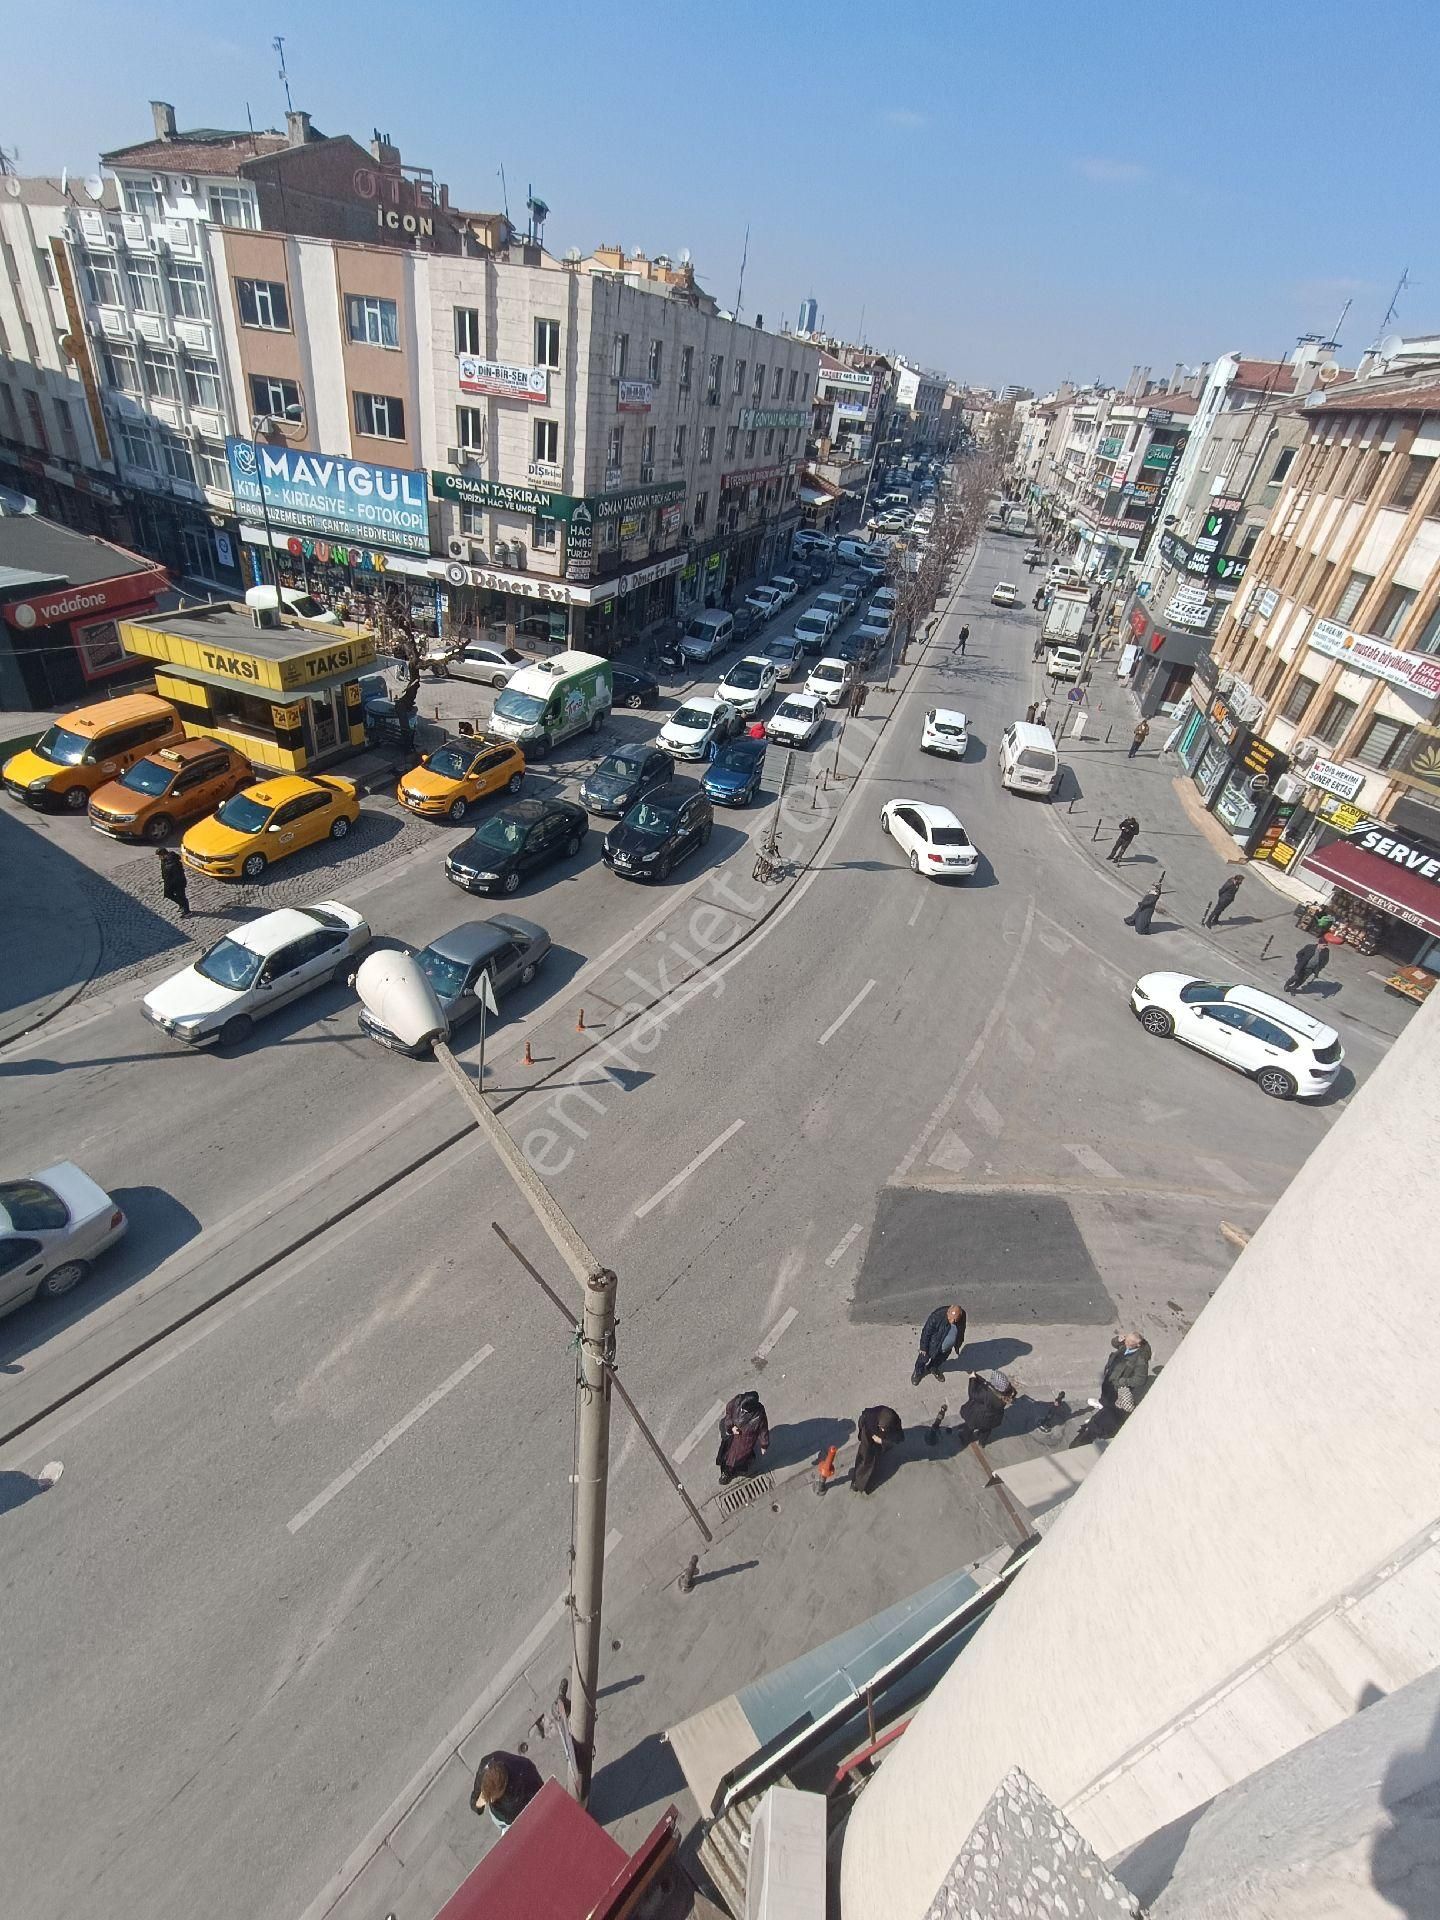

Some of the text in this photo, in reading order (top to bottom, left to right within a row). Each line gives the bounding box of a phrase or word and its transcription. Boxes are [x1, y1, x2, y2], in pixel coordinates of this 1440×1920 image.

[353, 168, 459, 214] OTEL
[261, 447, 422, 507] MAVİGÜL
[445, 476, 551, 507] OSMAN TAŞKIRAN
[458, 492, 537, 515] TURİZM HAC VE UMRE
[237, 479, 424, 530] KİTAP KIRTASİYE FOTOKOPİ
[322, 519, 350, 535] ÇANTA
[356, 526, 401, 544] HEDİYELİK
[402, 535, 425, 550] EŞYA
[567, 537, 592, 548] UMRE
[570, 524, 592, 537] HAC
[1187, 560, 1210, 573] UMRE
[1193, 552, 1211, 564] HAC
[470, 569, 574, 604] Döner Evi
[40, 592, 106, 618] vodafone
[305, 646, 354, 677] TAKSİ
[1351, 641, 1380, 660] mustafa
[203, 651, 260, 680] TAKSİ
[1418, 663, 1440, 679] HAC
[1412, 674, 1440, 691] UMRE
[1308, 771, 1332, 786] SONER
[1360, 831, 1440, 883] SERVE
[1366, 893, 1401, 913] SERVET
